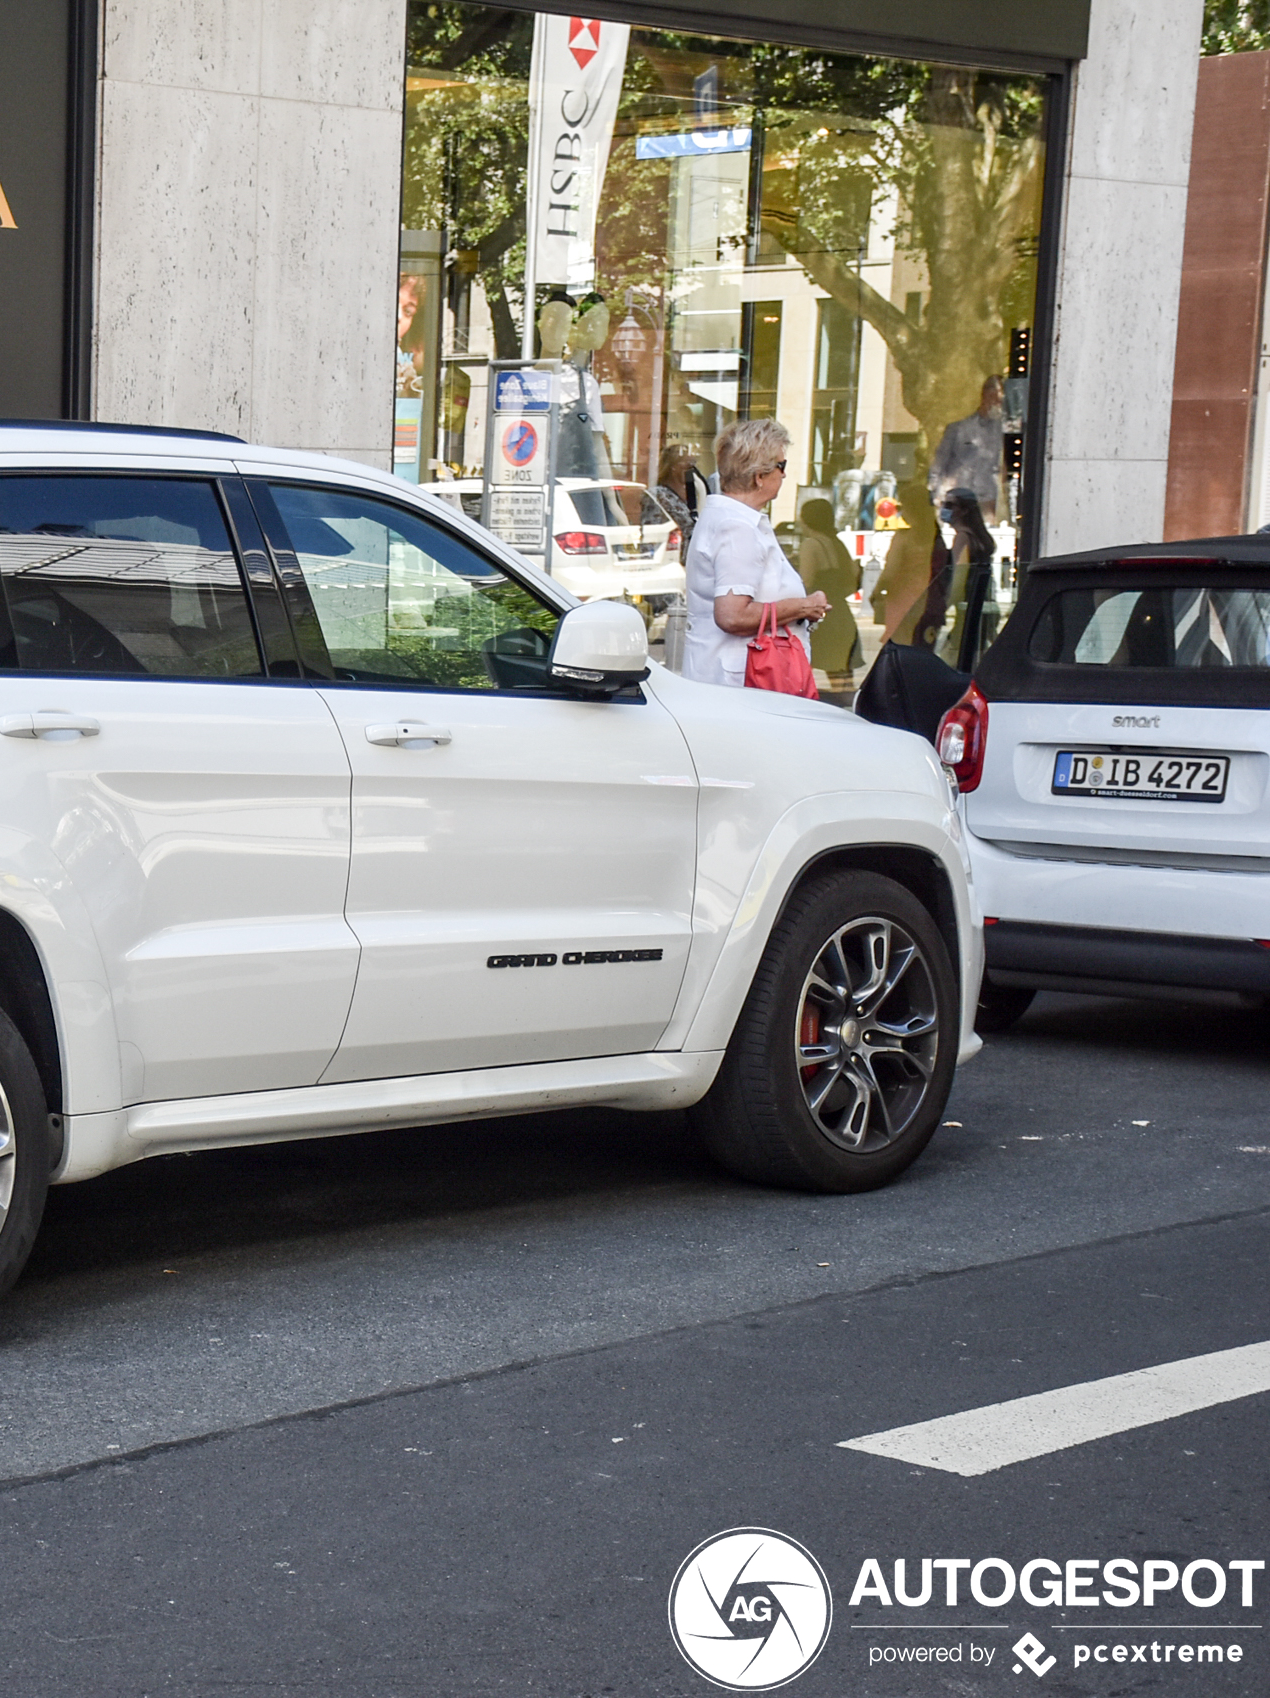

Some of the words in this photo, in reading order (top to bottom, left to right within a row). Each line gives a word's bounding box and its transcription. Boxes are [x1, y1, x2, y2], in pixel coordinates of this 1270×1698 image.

[547, 89, 589, 237] HSBC
[1112, 715, 1161, 728] smart
[1058, 774, 1066, 782] D
[1070, 757, 1088, 785] D
[1106, 759, 1141, 787] IB
[1147, 760, 1221, 791] 4272
[487, 953, 558, 969] GRAND
[562, 948, 664, 965] CHEROKEE
